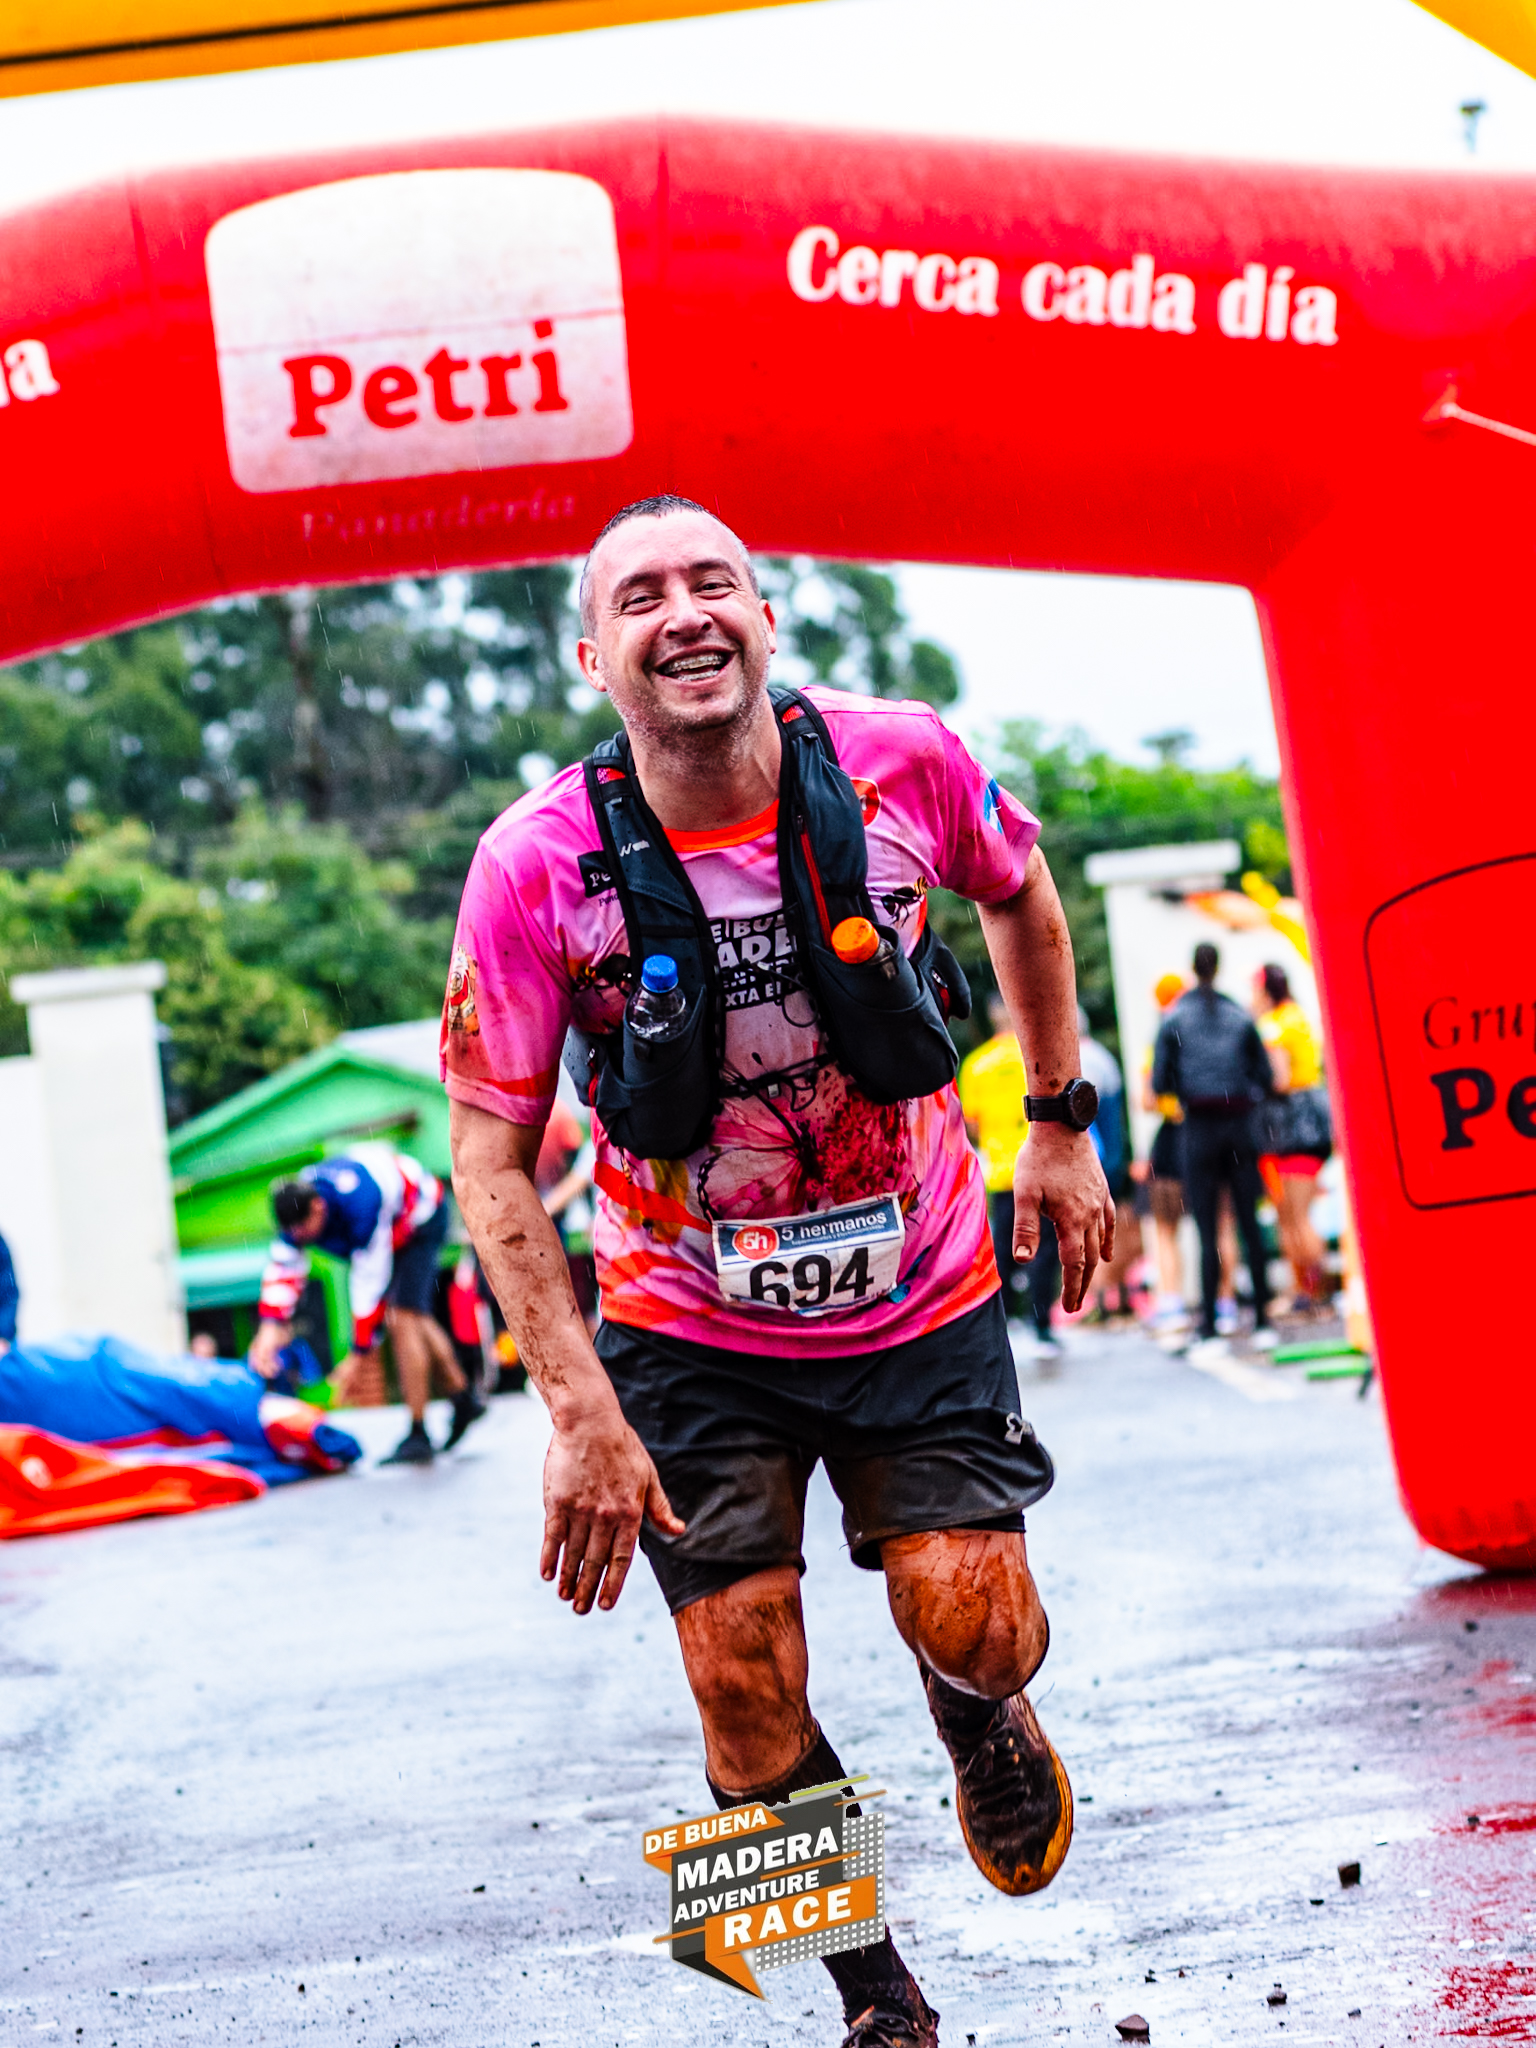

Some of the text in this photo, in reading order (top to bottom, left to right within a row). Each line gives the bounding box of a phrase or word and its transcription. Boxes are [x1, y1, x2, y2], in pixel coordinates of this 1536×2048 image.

[786, 225, 1339, 346] Cerca cada día
[283, 318, 571, 439] Petri
[1422, 995, 1536, 1054] Gru
[1429, 1067, 1536, 1152] Pe
[742, 1230, 768, 1250] 5h
[781, 1226, 794, 1242] 5
[799, 1211, 887, 1239] hermanos
[749, 1246, 875, 1308] 694
